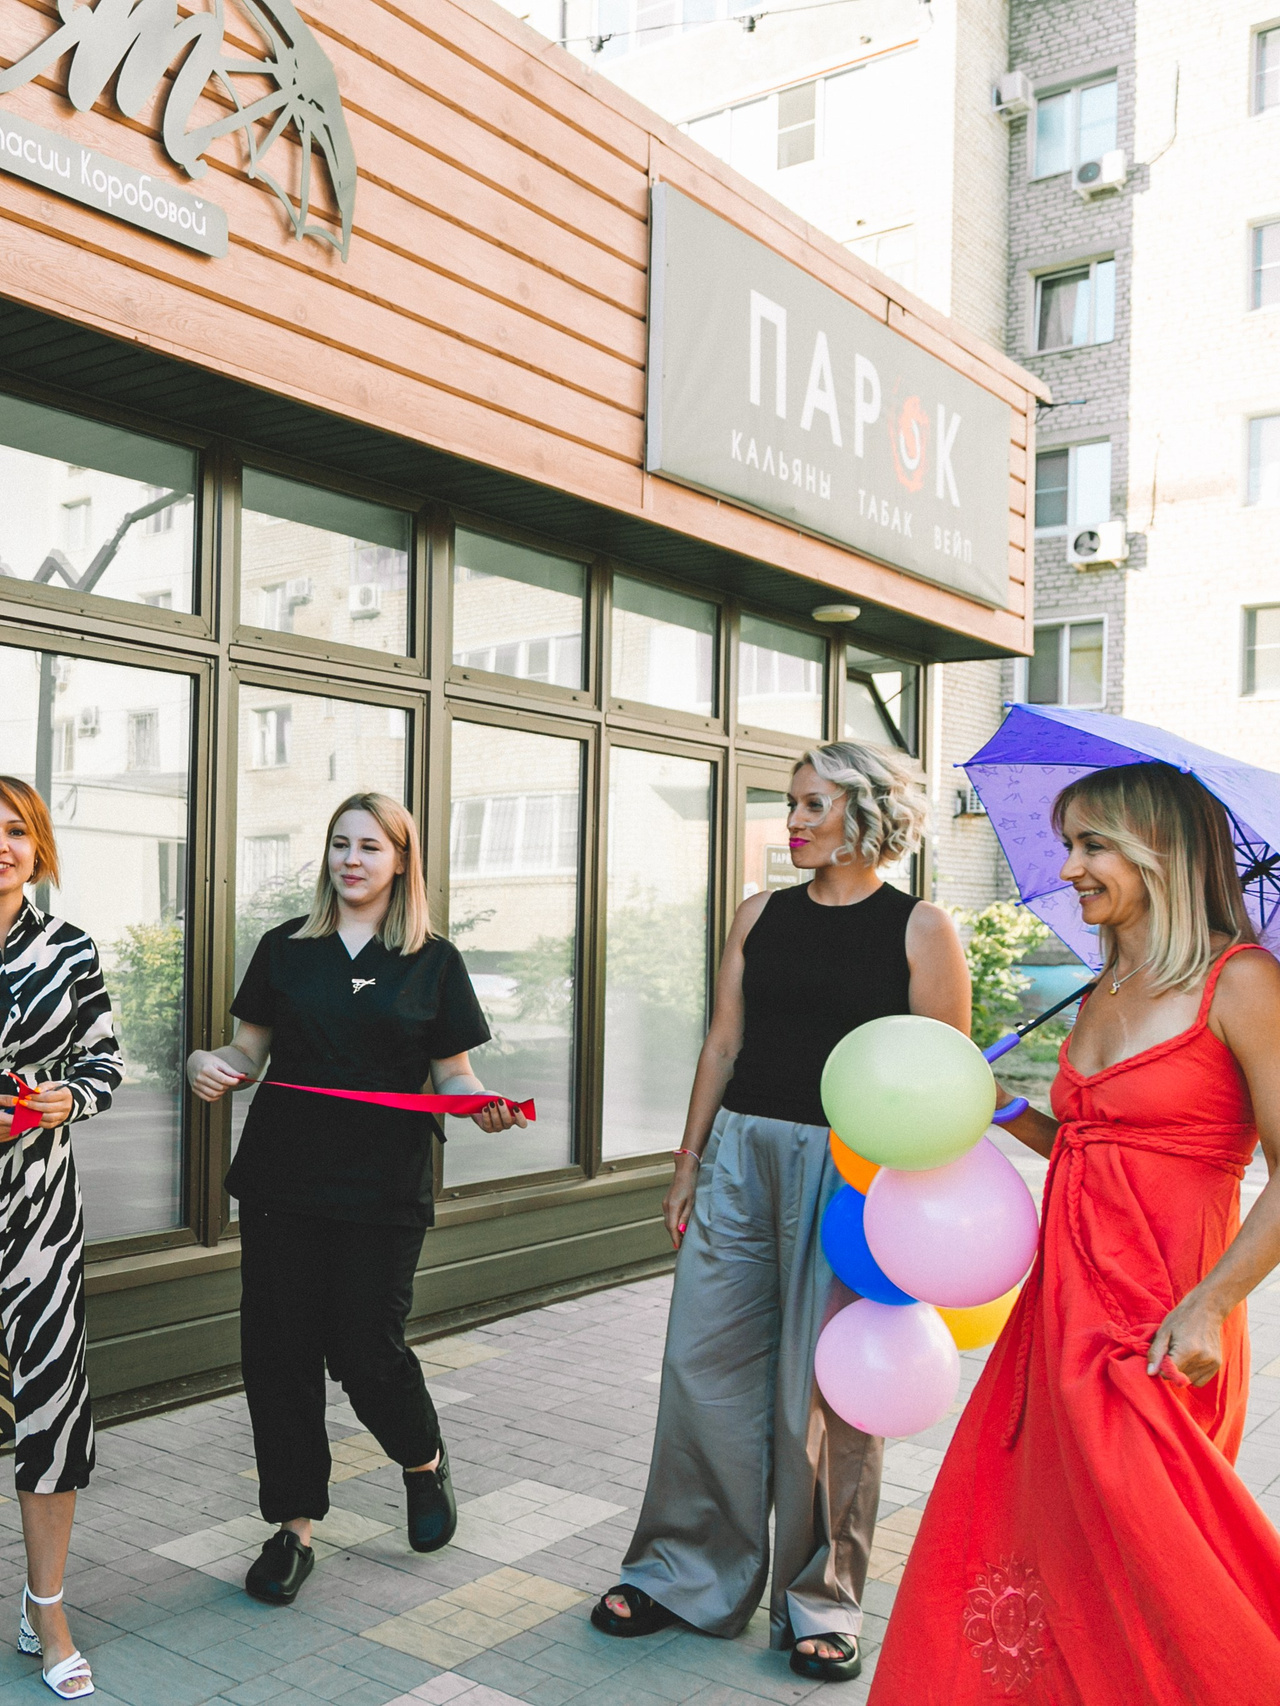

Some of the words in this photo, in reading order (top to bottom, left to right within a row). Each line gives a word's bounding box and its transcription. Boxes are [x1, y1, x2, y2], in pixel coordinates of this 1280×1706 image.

[81, 149, 207, 236] Коробовой
[731, 429, 832, 500] КАЛЬЯНЫ
[858, 489, 913, 538] ТАБАК
[934, 525, 973, 564] ВЕЙП
